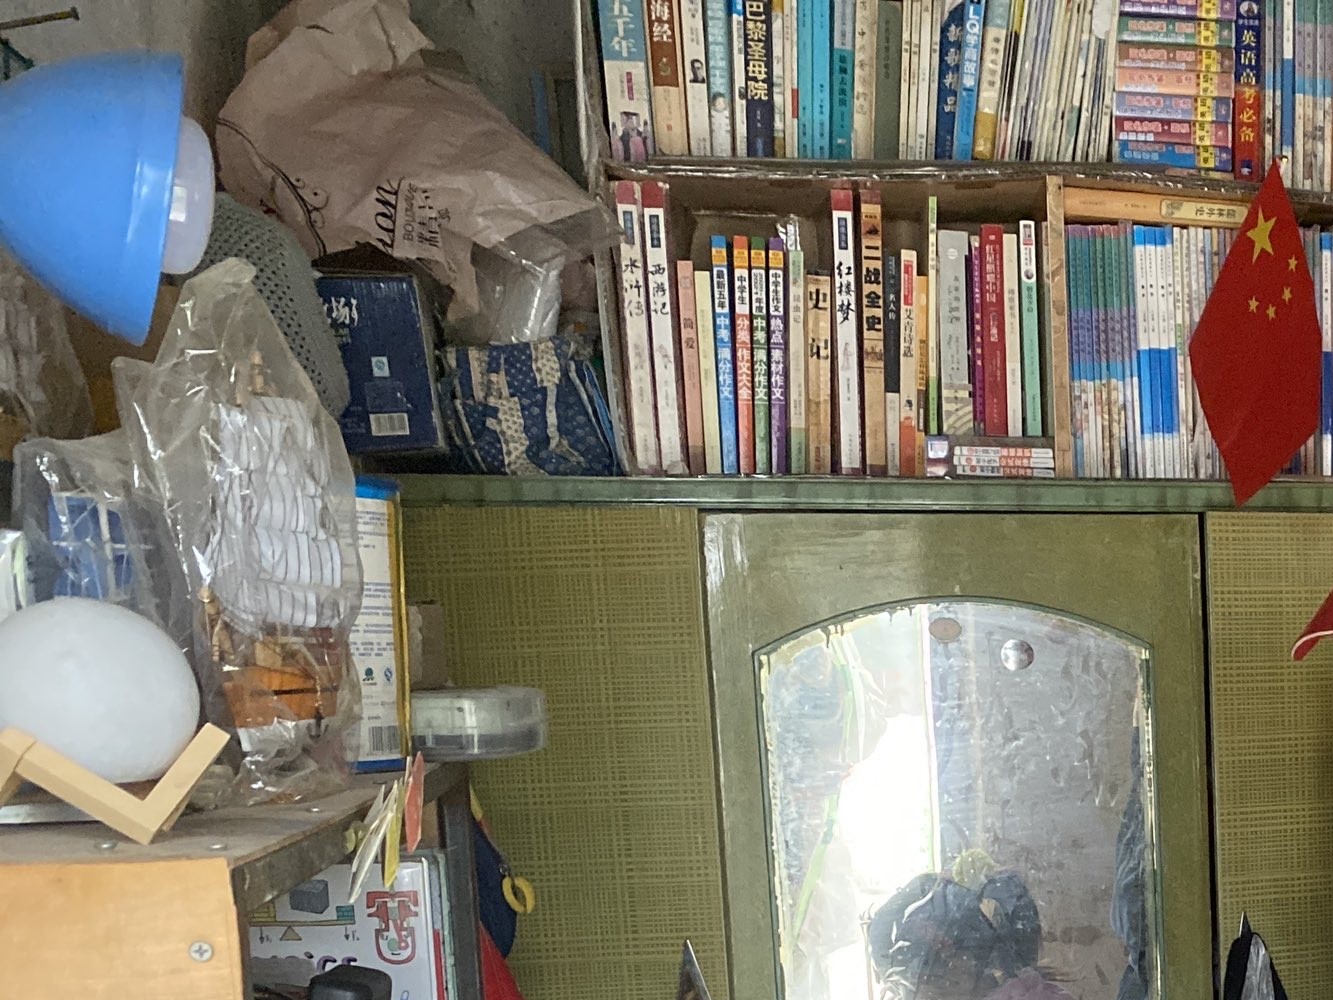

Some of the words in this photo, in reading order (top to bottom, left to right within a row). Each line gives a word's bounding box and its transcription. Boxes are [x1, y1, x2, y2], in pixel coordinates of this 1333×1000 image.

[745, 1, 768, 100] 巴黎圣母院
[1240, 29, 1257, 142] 英语高考必备
[1195, 204, 1237, 219] 儒林外史
[622, 257, 644, 317] 水浒传
[648, 263, 669, 315] 西游记
[716, 269, 727, 310] 最新五年
[737, 275, 747, 305] 中学生
[836, 261, 855, 324] 红楼梦
[863, 245, 882, 332] 二战全史
[809, 288, 829, 360] 史记
[902, 308, 914, 358] 艾青诗选
